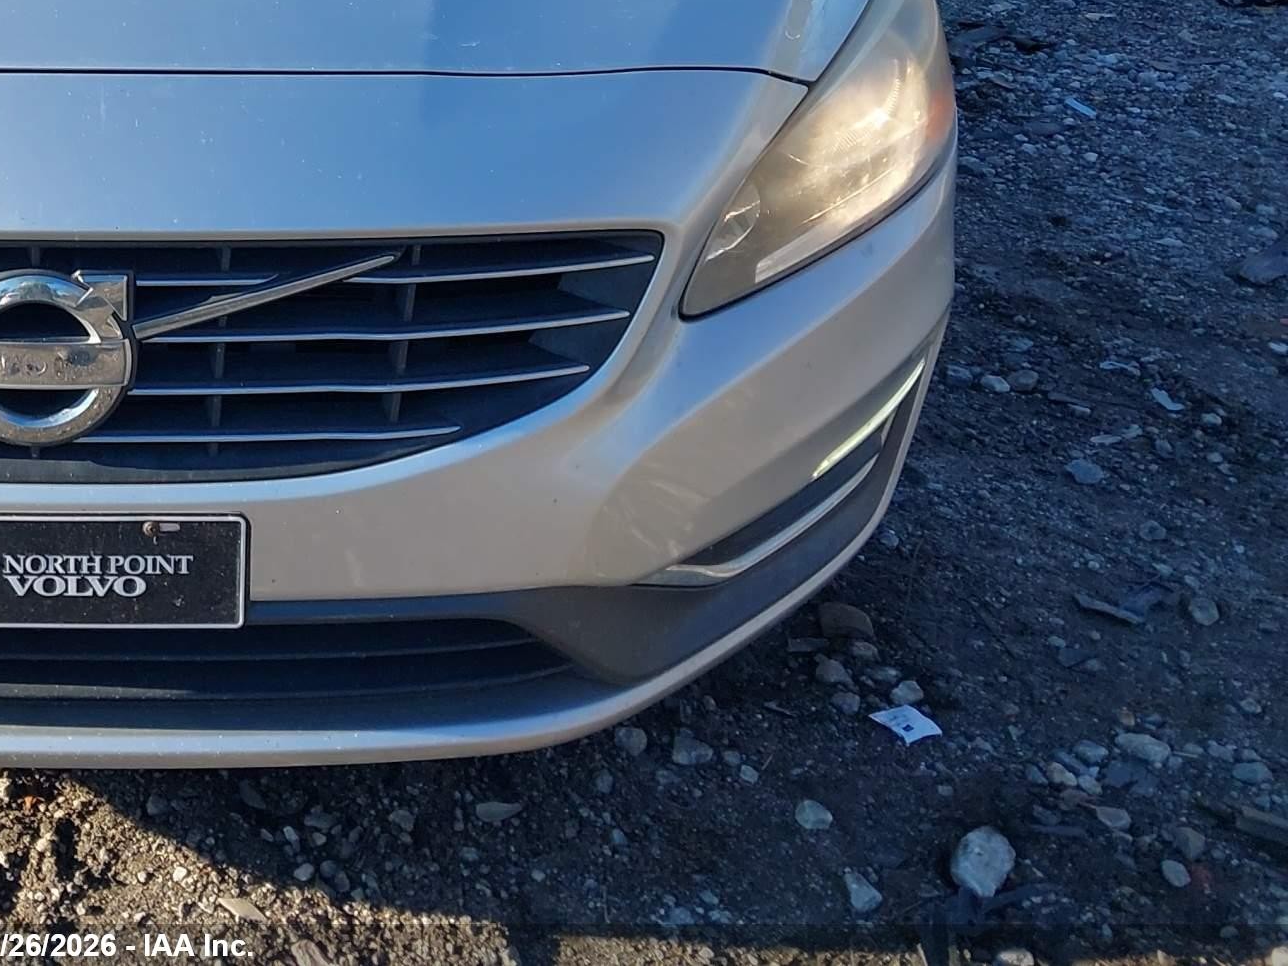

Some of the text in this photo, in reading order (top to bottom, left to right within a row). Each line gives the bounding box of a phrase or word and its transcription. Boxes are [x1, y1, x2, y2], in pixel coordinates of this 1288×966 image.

[2, 554, 194, 575] NORTH POINT
[2, 574, 147, 597] VOLVO
